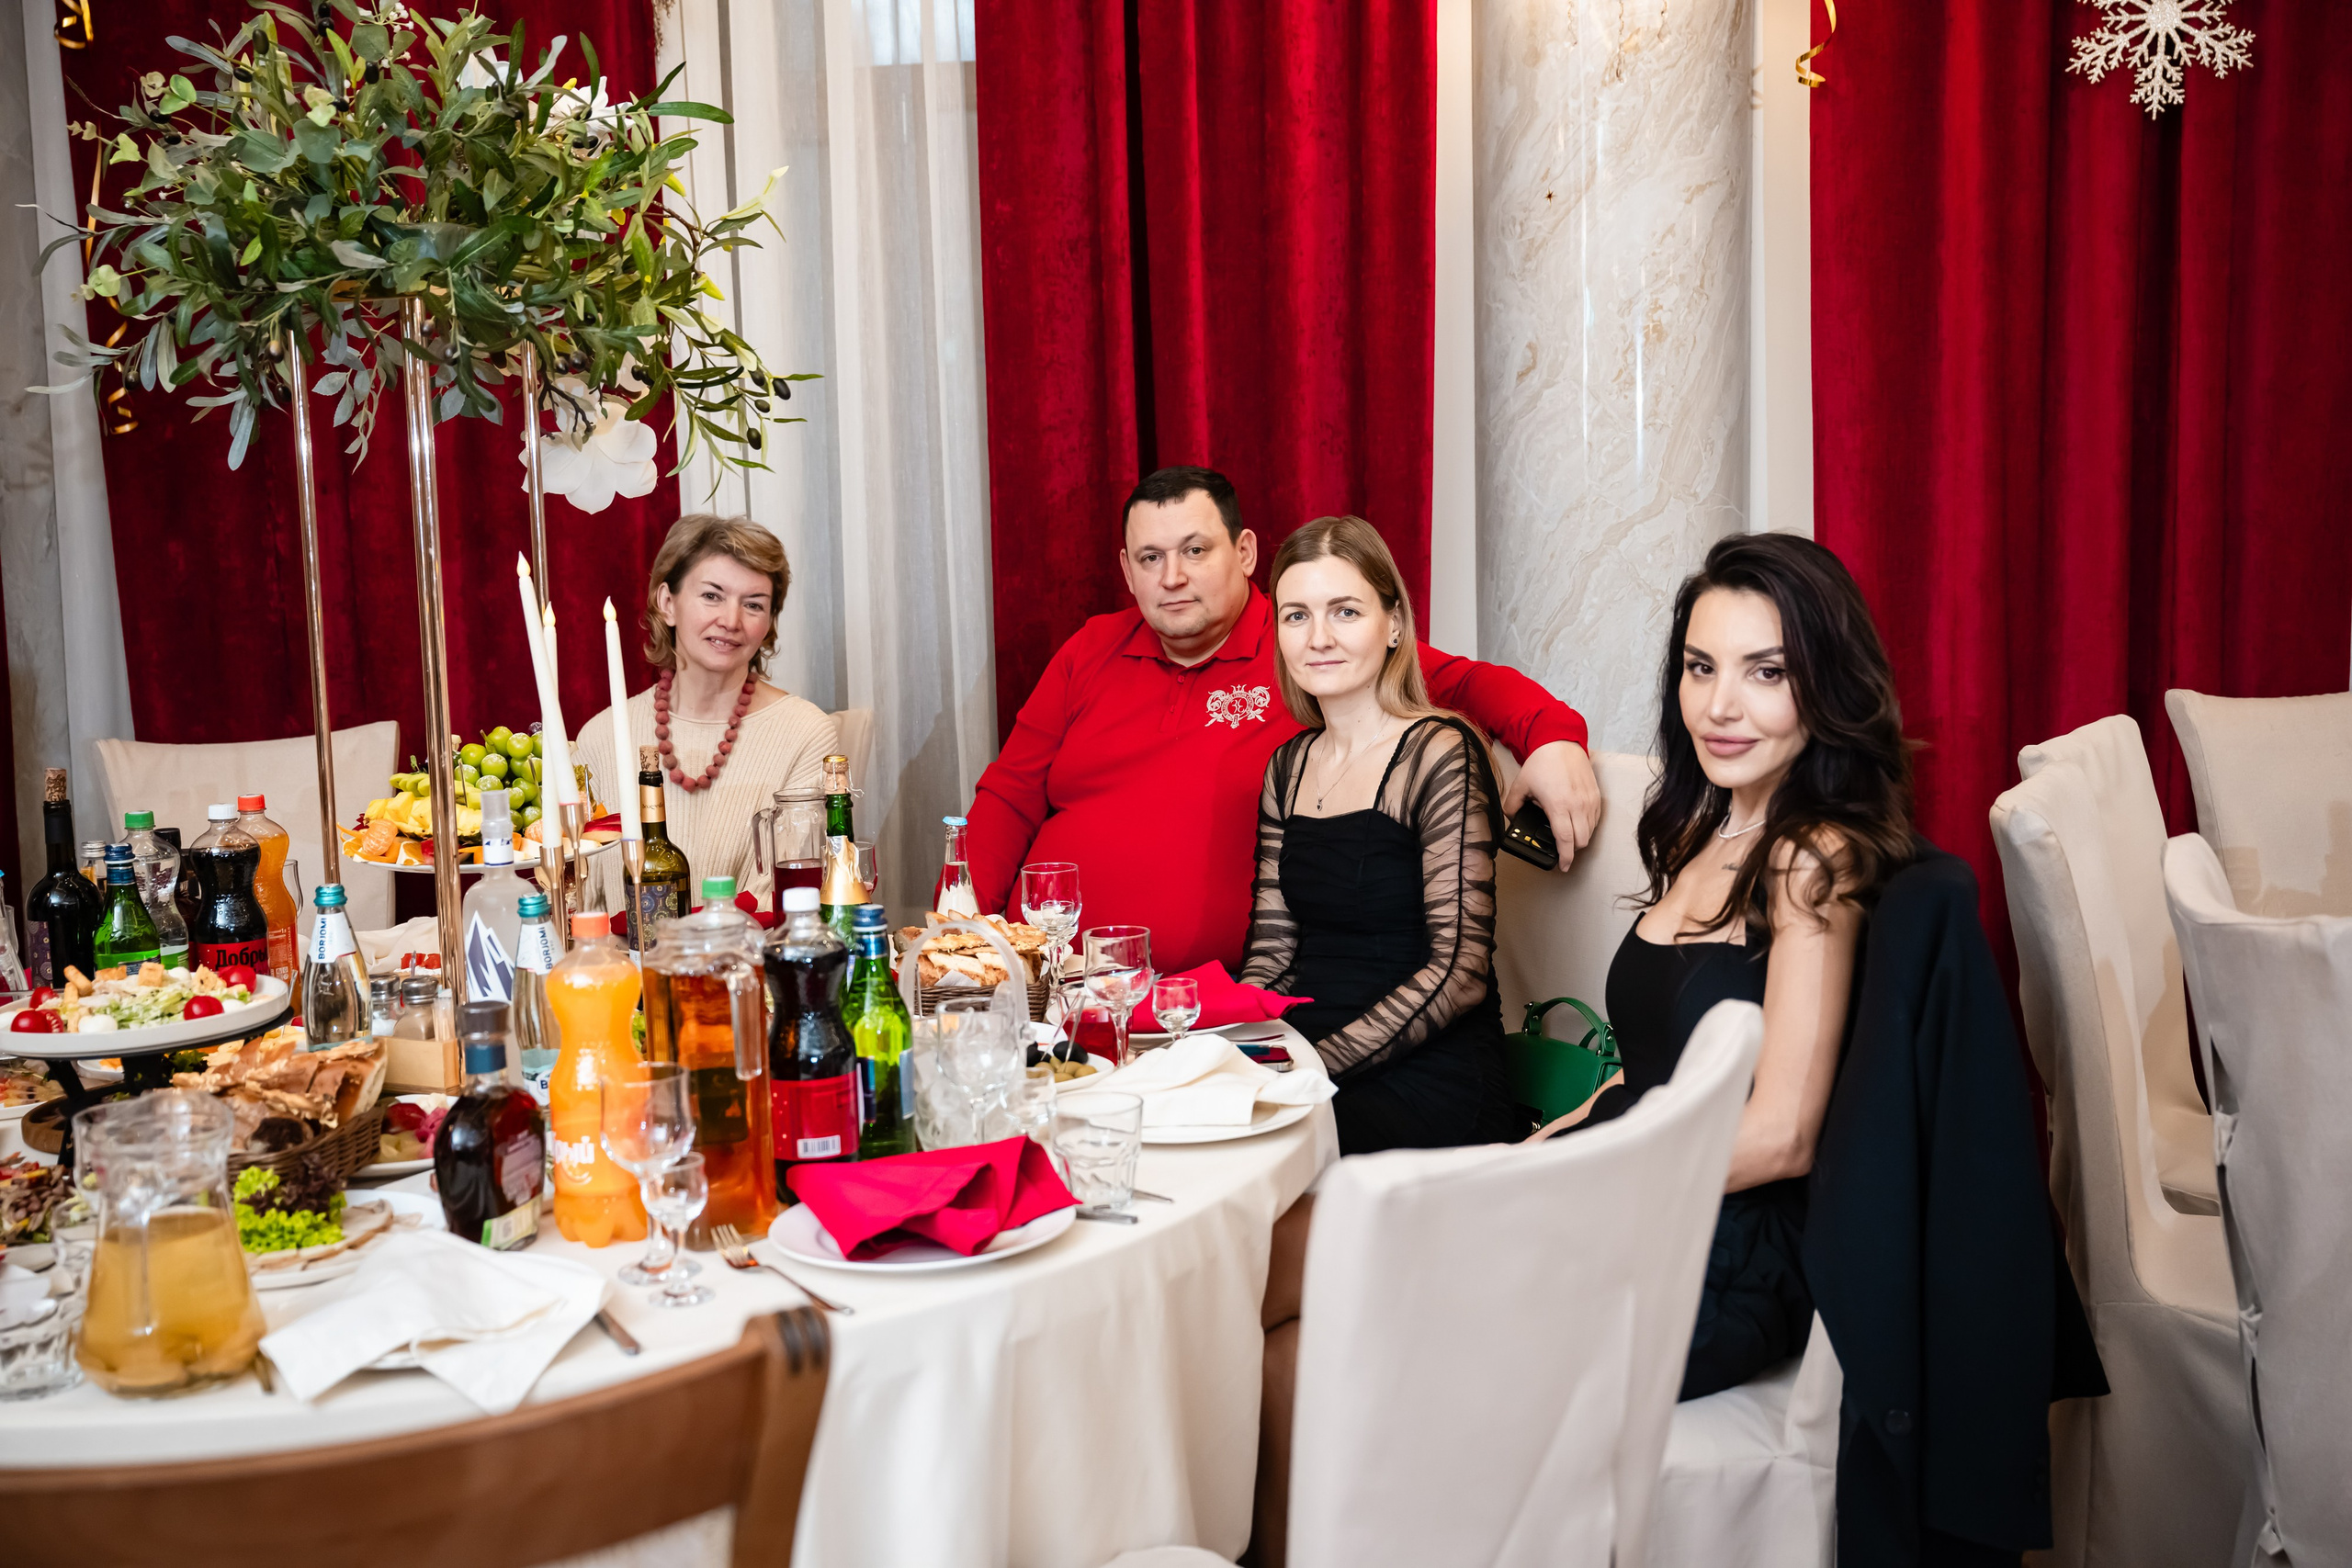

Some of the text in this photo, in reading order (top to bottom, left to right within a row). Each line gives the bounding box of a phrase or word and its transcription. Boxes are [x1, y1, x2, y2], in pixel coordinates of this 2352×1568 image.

[318, 918, 327, 960] BORJOMI
[537, 927, 553, 970] BORJOMI
[215, 946, 267, 970] Добры
[553, 1135, 594, 1166] рый
